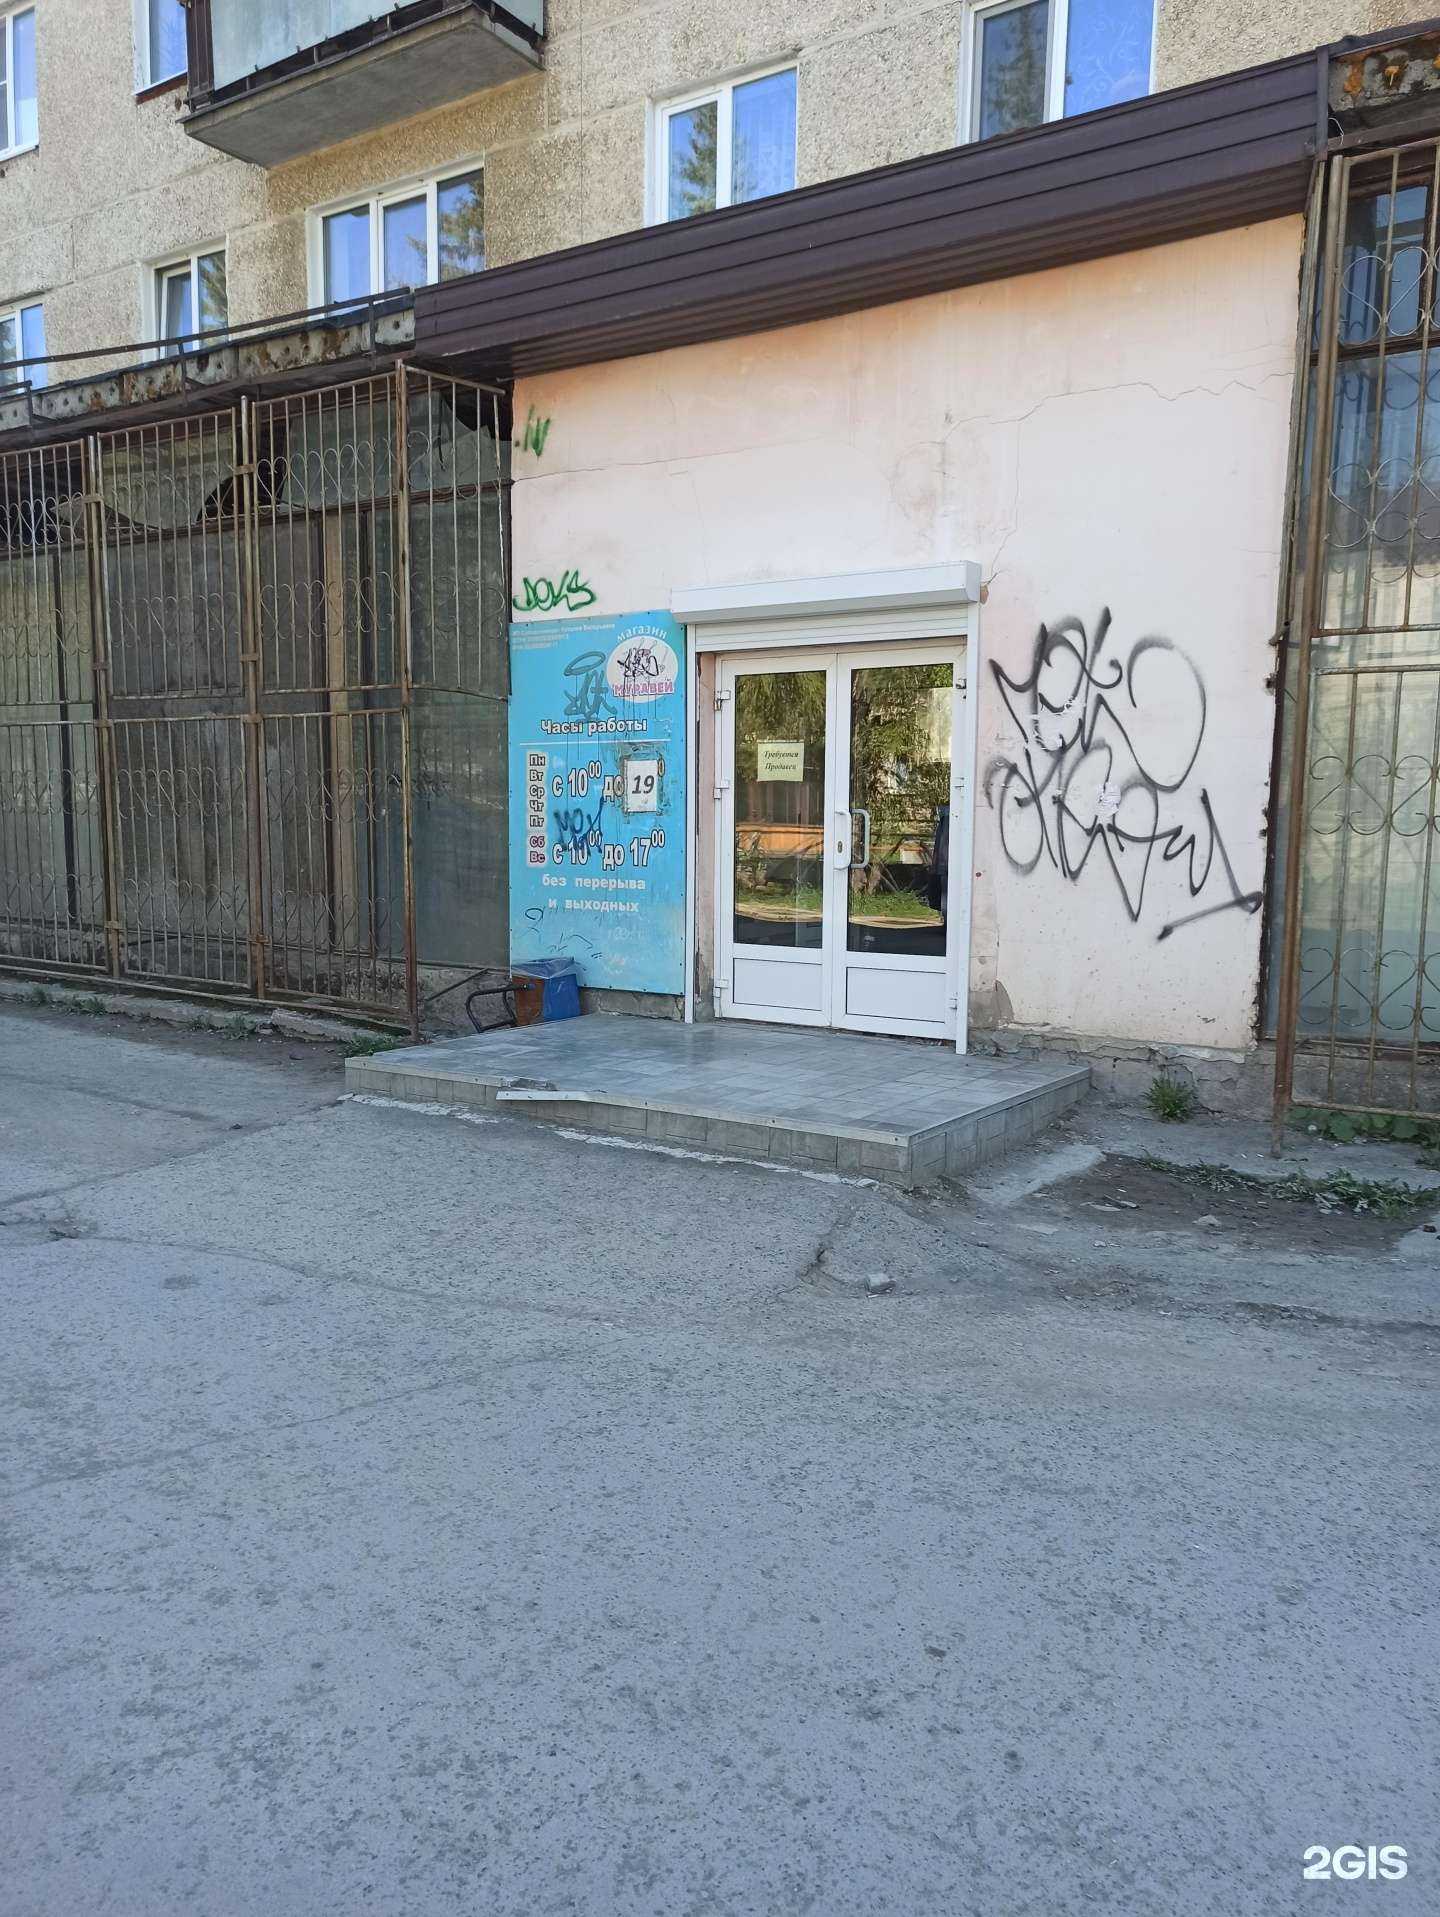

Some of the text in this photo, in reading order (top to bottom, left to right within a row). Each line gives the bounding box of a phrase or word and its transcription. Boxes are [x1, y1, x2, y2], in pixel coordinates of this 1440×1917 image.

[617, 625, 667, 641] магазин
[613, 677, 674, 697] МУРАВЕЙ
[541, 717, 648, 735] Часы работы
[530, 754, 545, 766] Пн
[530, 770, 543, 781] Вт
[530, 785, 545, 799] Ср
[602, 775, 625, 803] до
[632, 775, 655, 794] 19
[530, 800, 544, 812] Чт
[530, 815, 544, 827] Пт
[530, 836, 545, 847] Сб
[530, 851, 545, 863] Вс
[602, 844, 625, 871] до
[542, 874, 646, 890] без перерыва
[548, 898, 640, 912] и выходных
